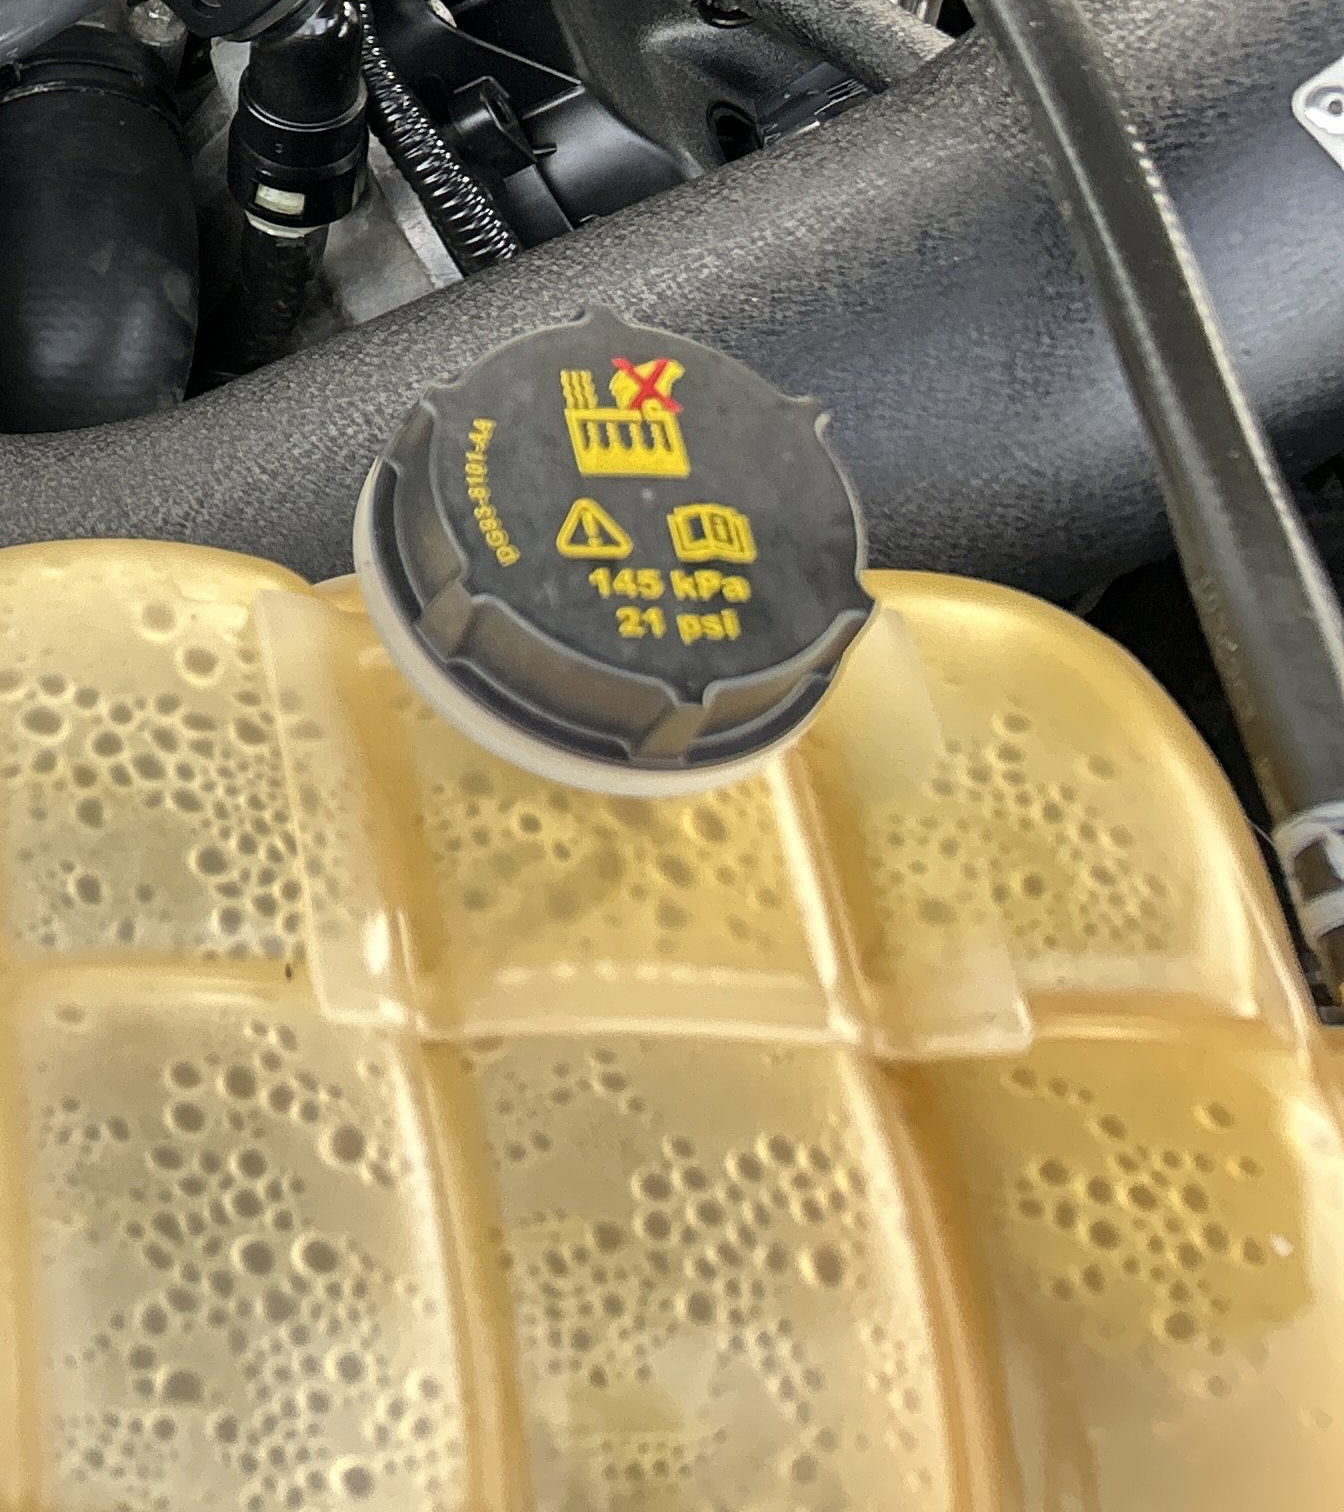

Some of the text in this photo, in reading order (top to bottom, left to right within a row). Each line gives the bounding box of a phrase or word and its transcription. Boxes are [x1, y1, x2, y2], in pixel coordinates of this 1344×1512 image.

[588, 566, 751, 603] 145 kPa
[616, 606, 740, 644] 21 psi
